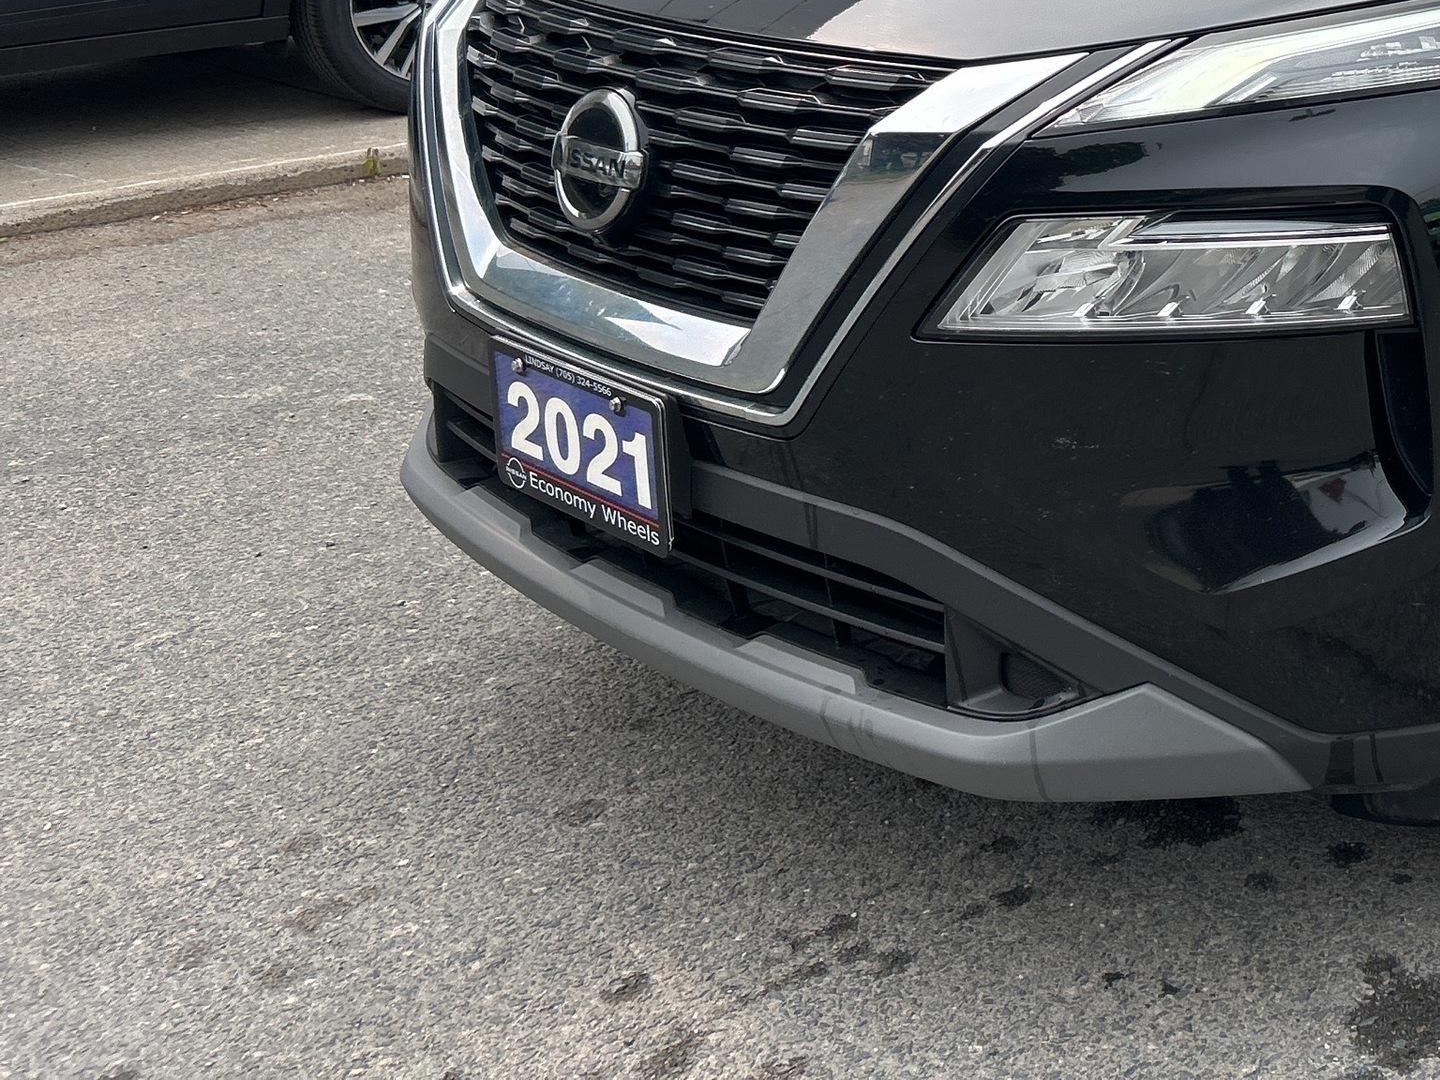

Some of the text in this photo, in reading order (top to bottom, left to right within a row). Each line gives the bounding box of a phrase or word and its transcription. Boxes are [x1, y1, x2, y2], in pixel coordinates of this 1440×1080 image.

[524, 353, 555, 373] LINDSAY
[555, 367, 576, 384] (705)
[507, 381, 653, 510] 2021
[529, 470, 597, 519] Economy
[601, 504, 661, 547] Wheels
